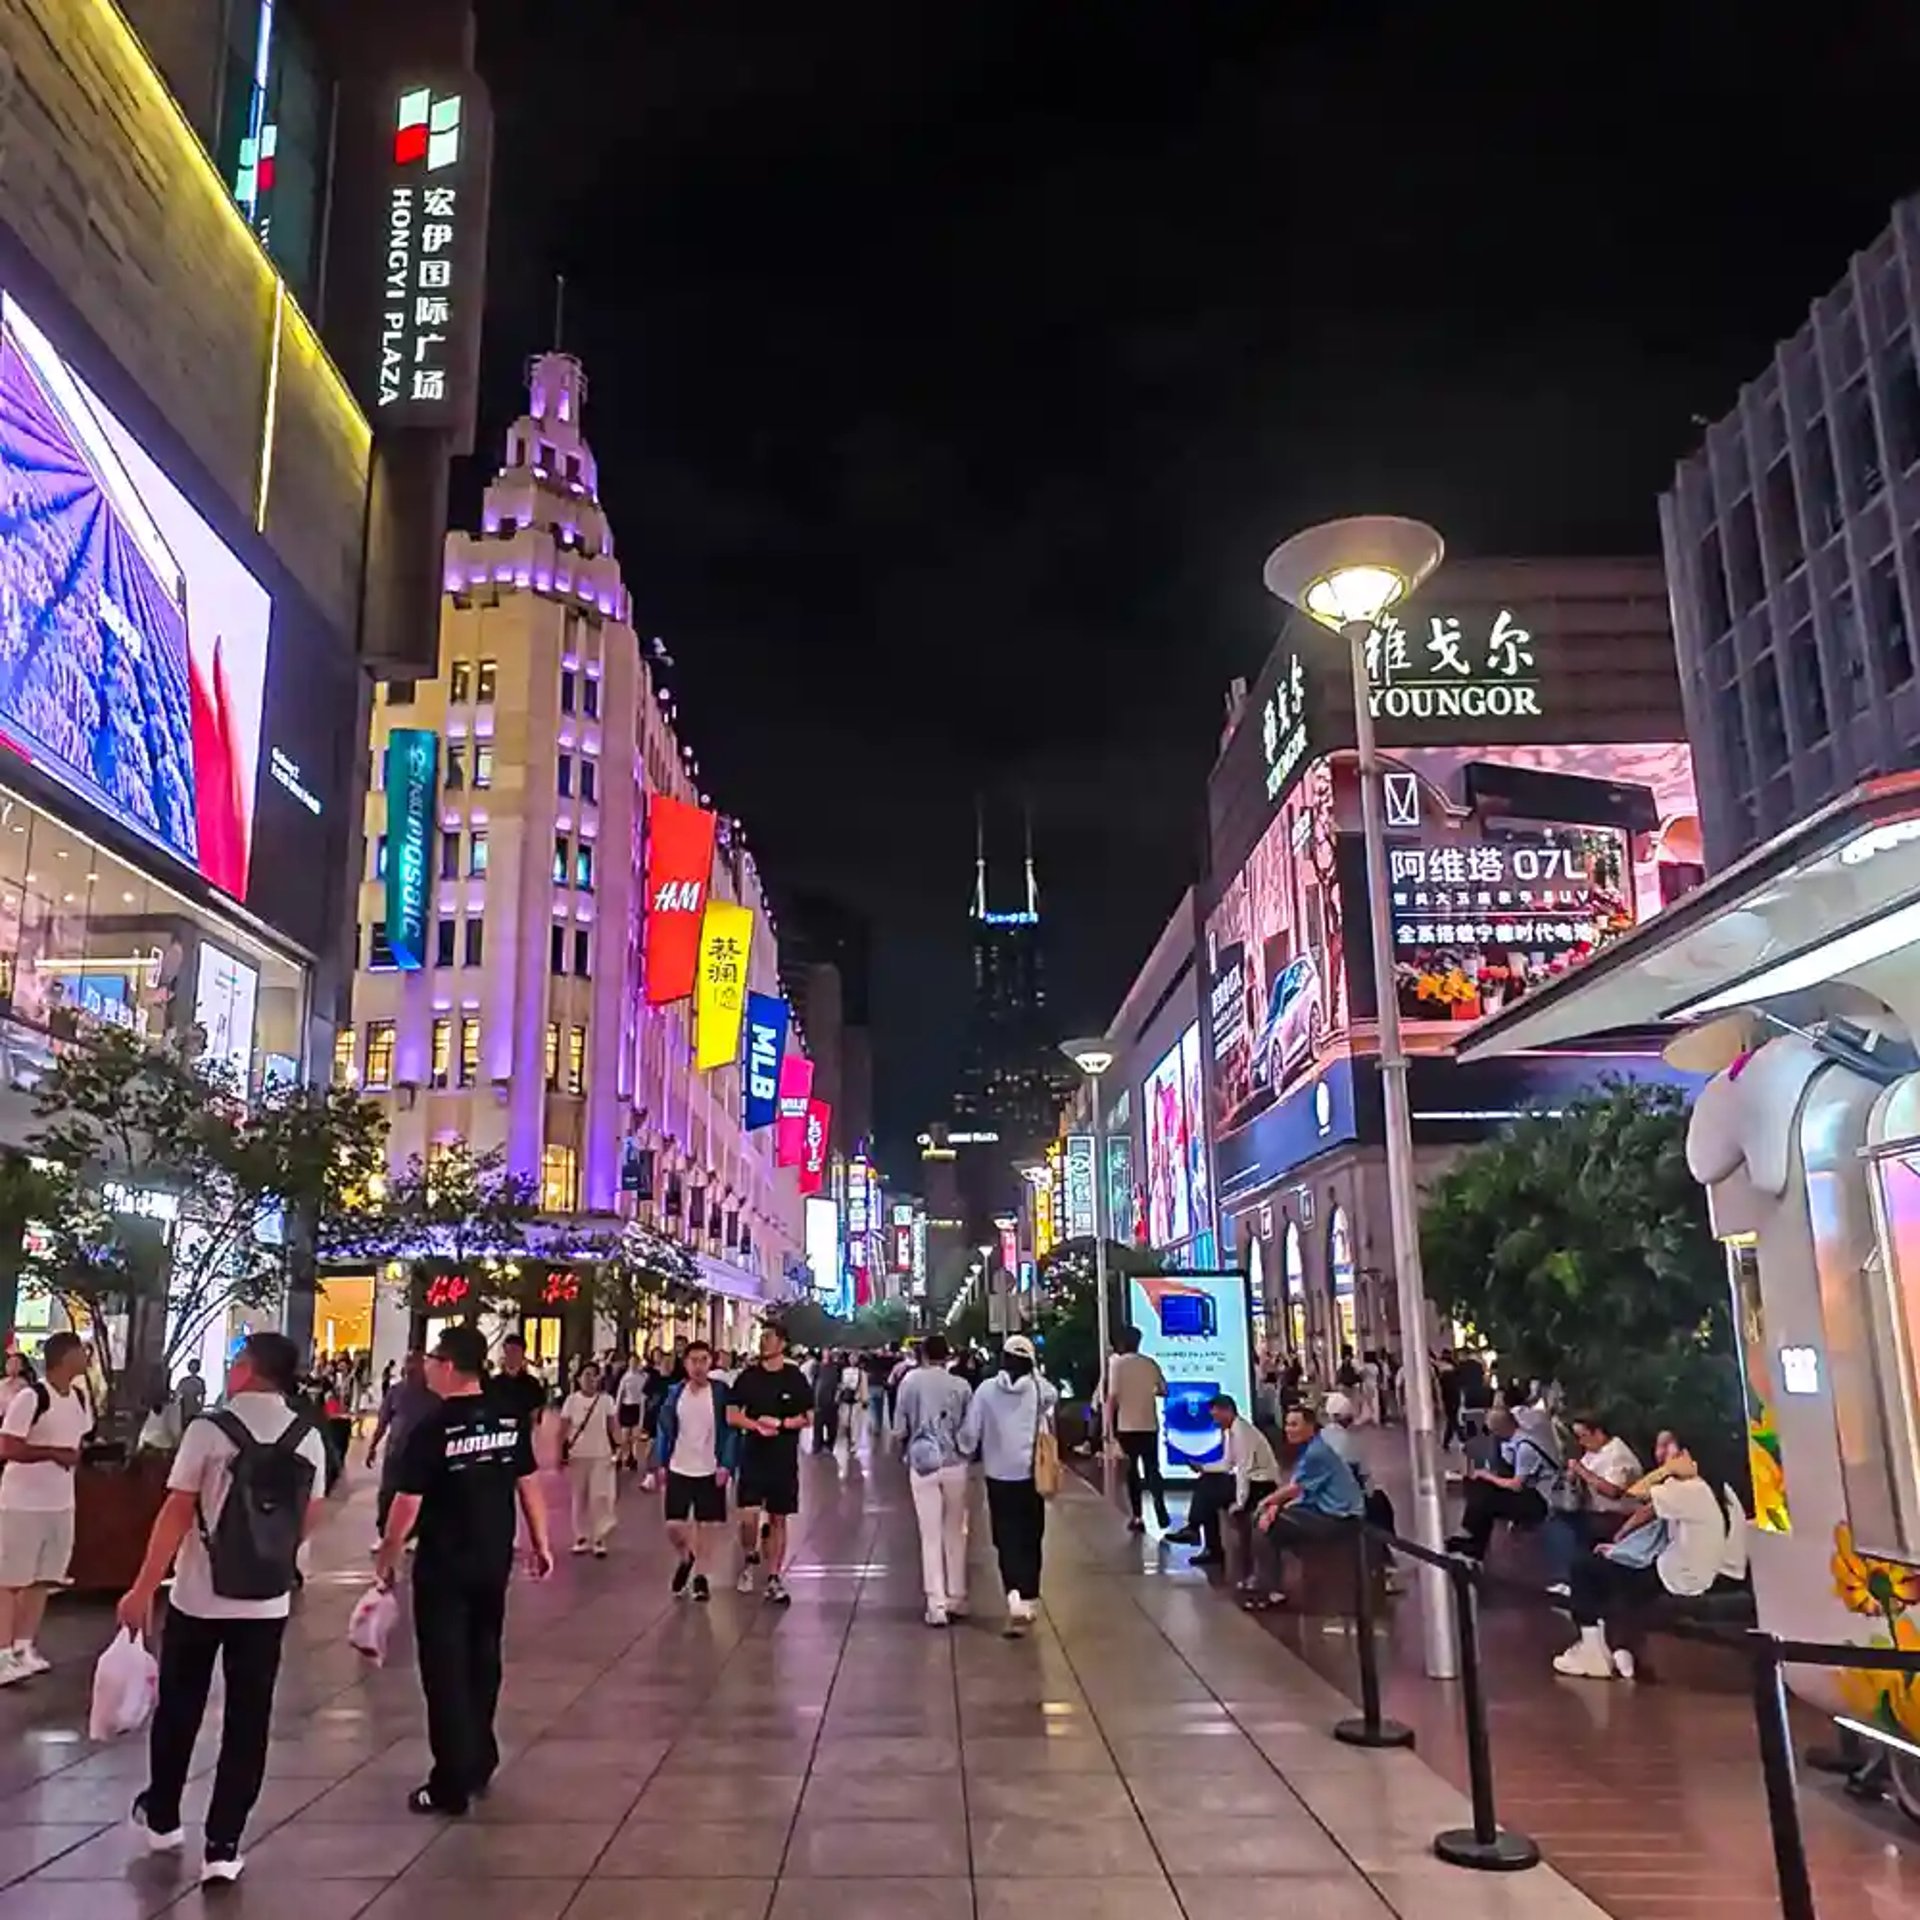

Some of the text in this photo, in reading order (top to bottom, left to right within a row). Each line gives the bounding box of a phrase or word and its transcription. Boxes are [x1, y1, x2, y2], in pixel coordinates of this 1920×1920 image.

[378, 188, 413, 407] HONGYI PLAZA
[410, 187, 456, 400] 宏伊国际广场
[1365, 611, 1534, 686] 雅戈尔
[1368, 686, 1542, 718] YOUNGOR
[654, 881, 703, 913] H&M
[1390, 848, 1588, 884] 阿维塔 07L
[751, 1023, 777, 1101] MLB
